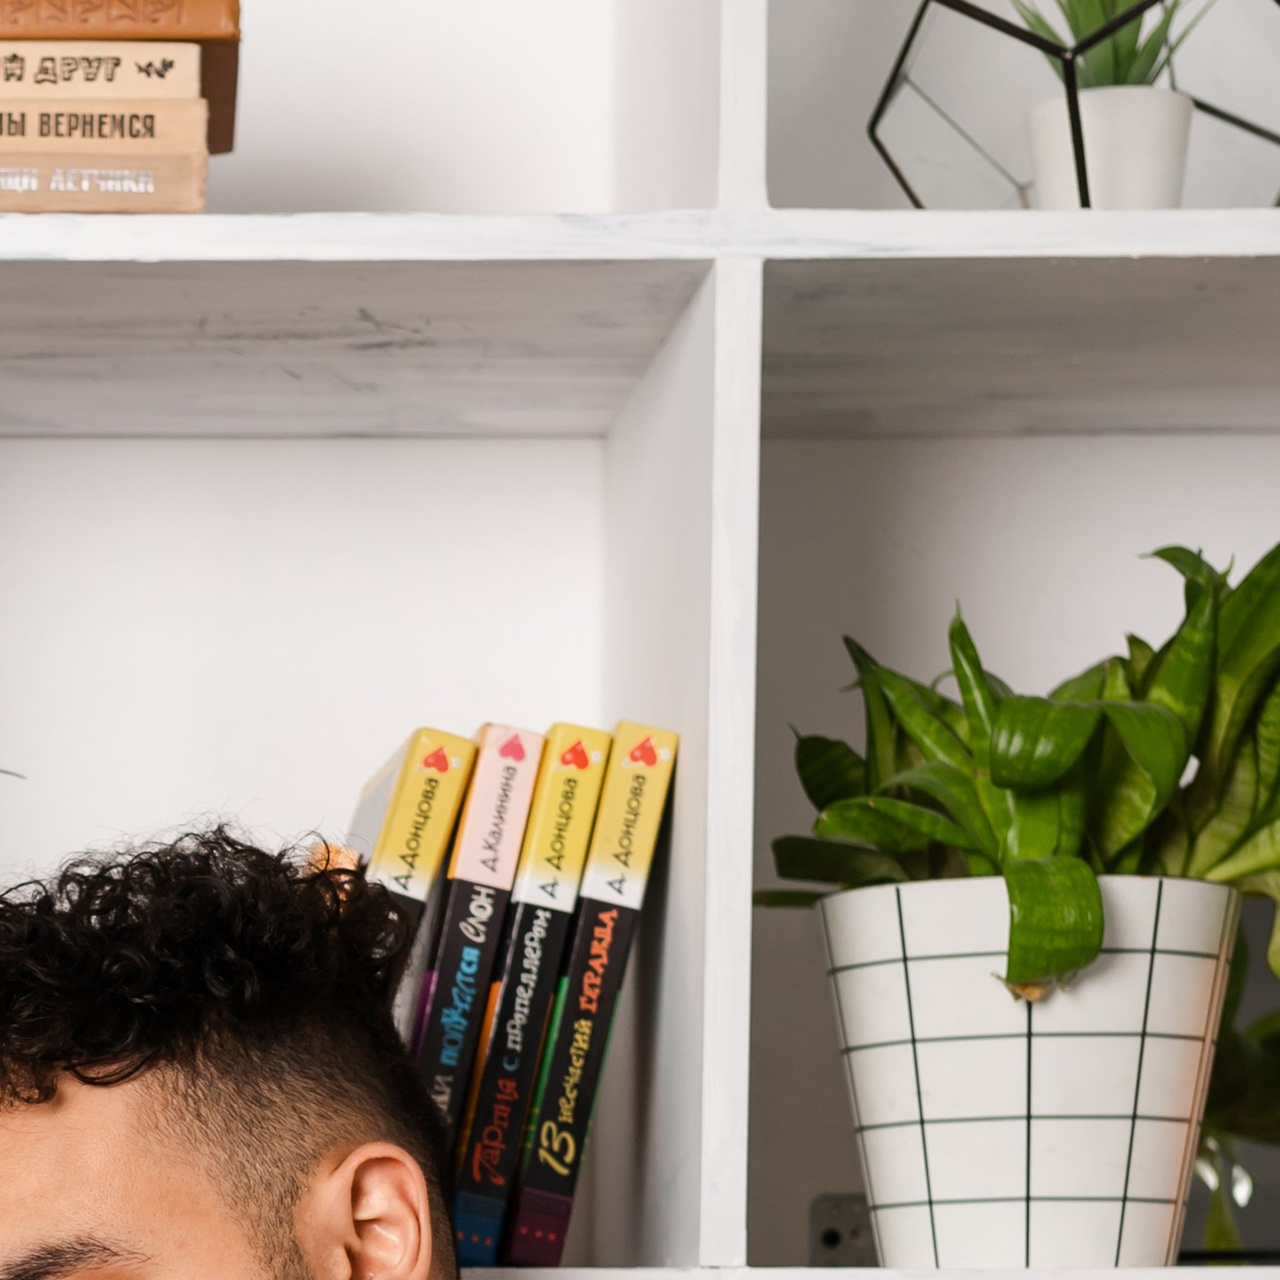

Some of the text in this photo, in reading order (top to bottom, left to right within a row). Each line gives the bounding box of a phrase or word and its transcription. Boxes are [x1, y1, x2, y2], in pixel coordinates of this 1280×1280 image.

[34, 55, 121, 84] ДРУГ
[39, 112, 156, 139] ВЕРНЕМСЯ
[545, 776, 579, 872] Донцова
[614, 773, 647, 868] Донцова
[538, 1119, 577, 1177] 13
